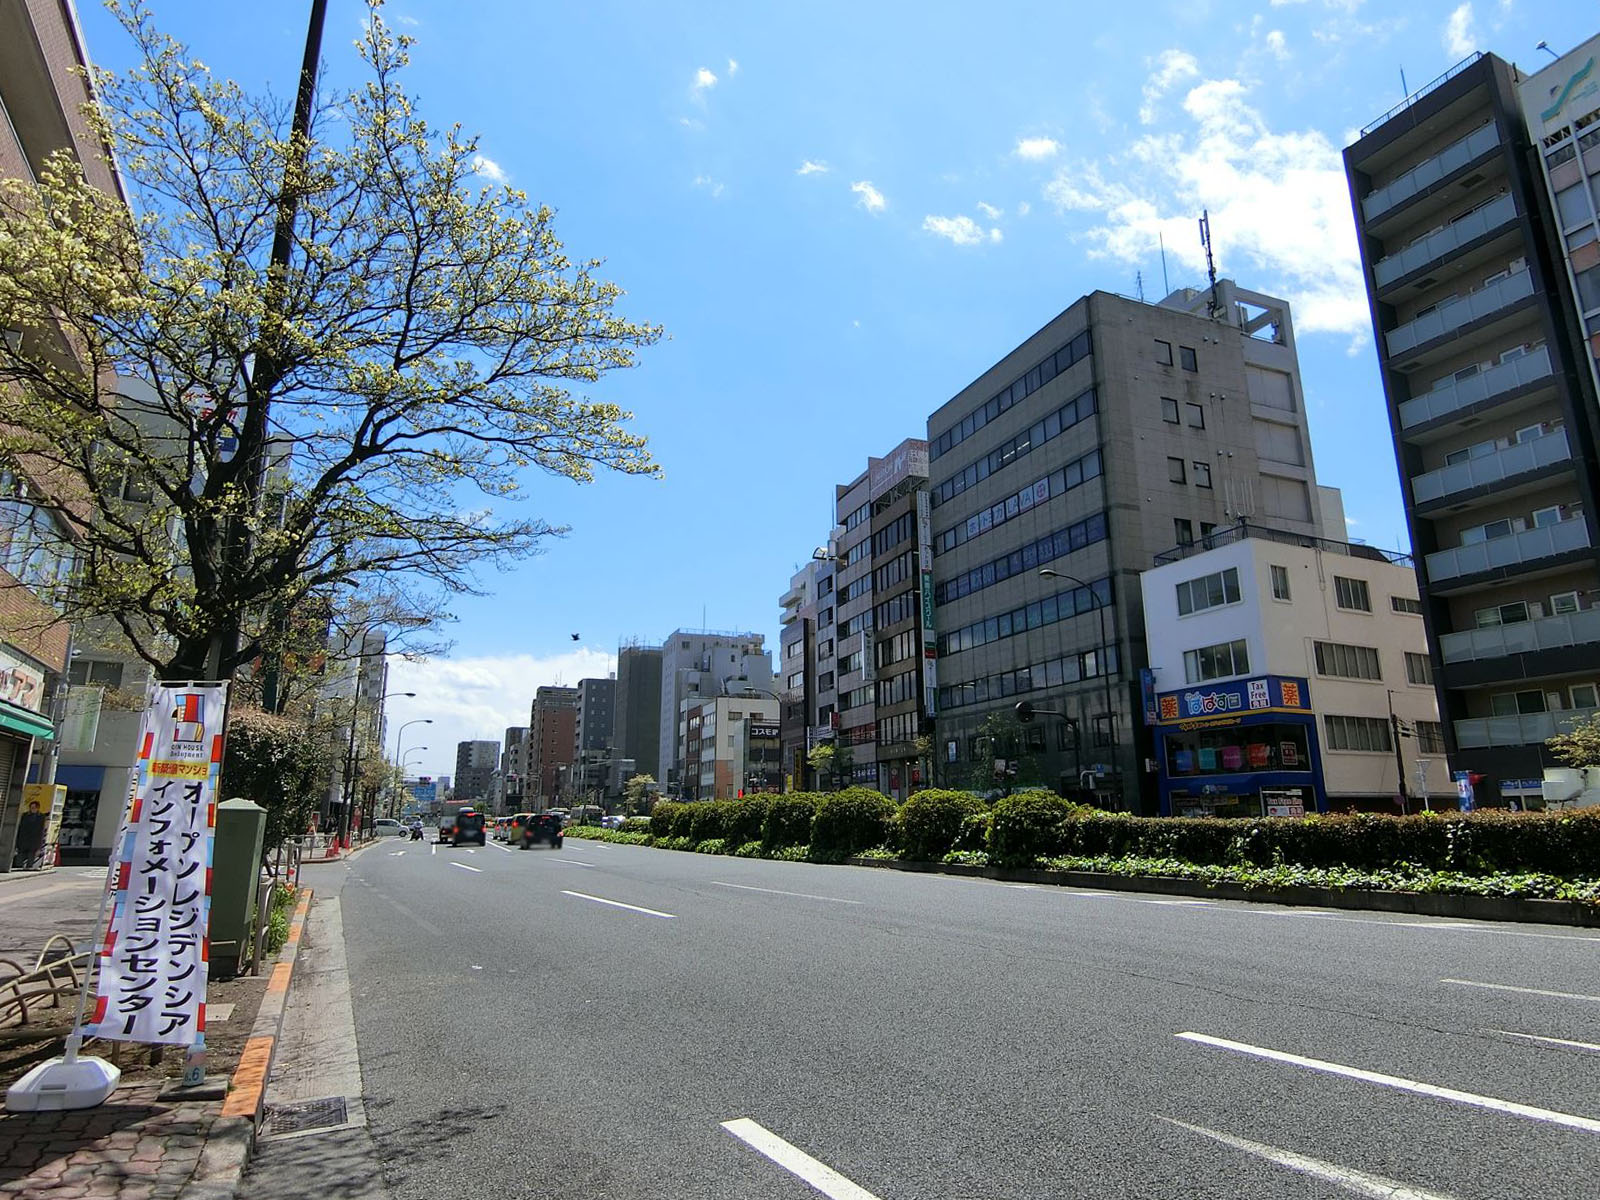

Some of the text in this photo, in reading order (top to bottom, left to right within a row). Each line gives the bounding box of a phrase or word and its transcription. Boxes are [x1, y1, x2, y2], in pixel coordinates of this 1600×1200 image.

[1250, 691, 1266, 699] Free
[1251, 682, 1264, 690] Tax
[1282, 683, 1299, 704] 薬
[1161, 697, 1178, 718] 薬
[183, 744, 205, 752] HOUSE
[117, 780, 176, 1034] インフォメーションセンター
[158, 781, 203, 1037] オープンレジデンシア
